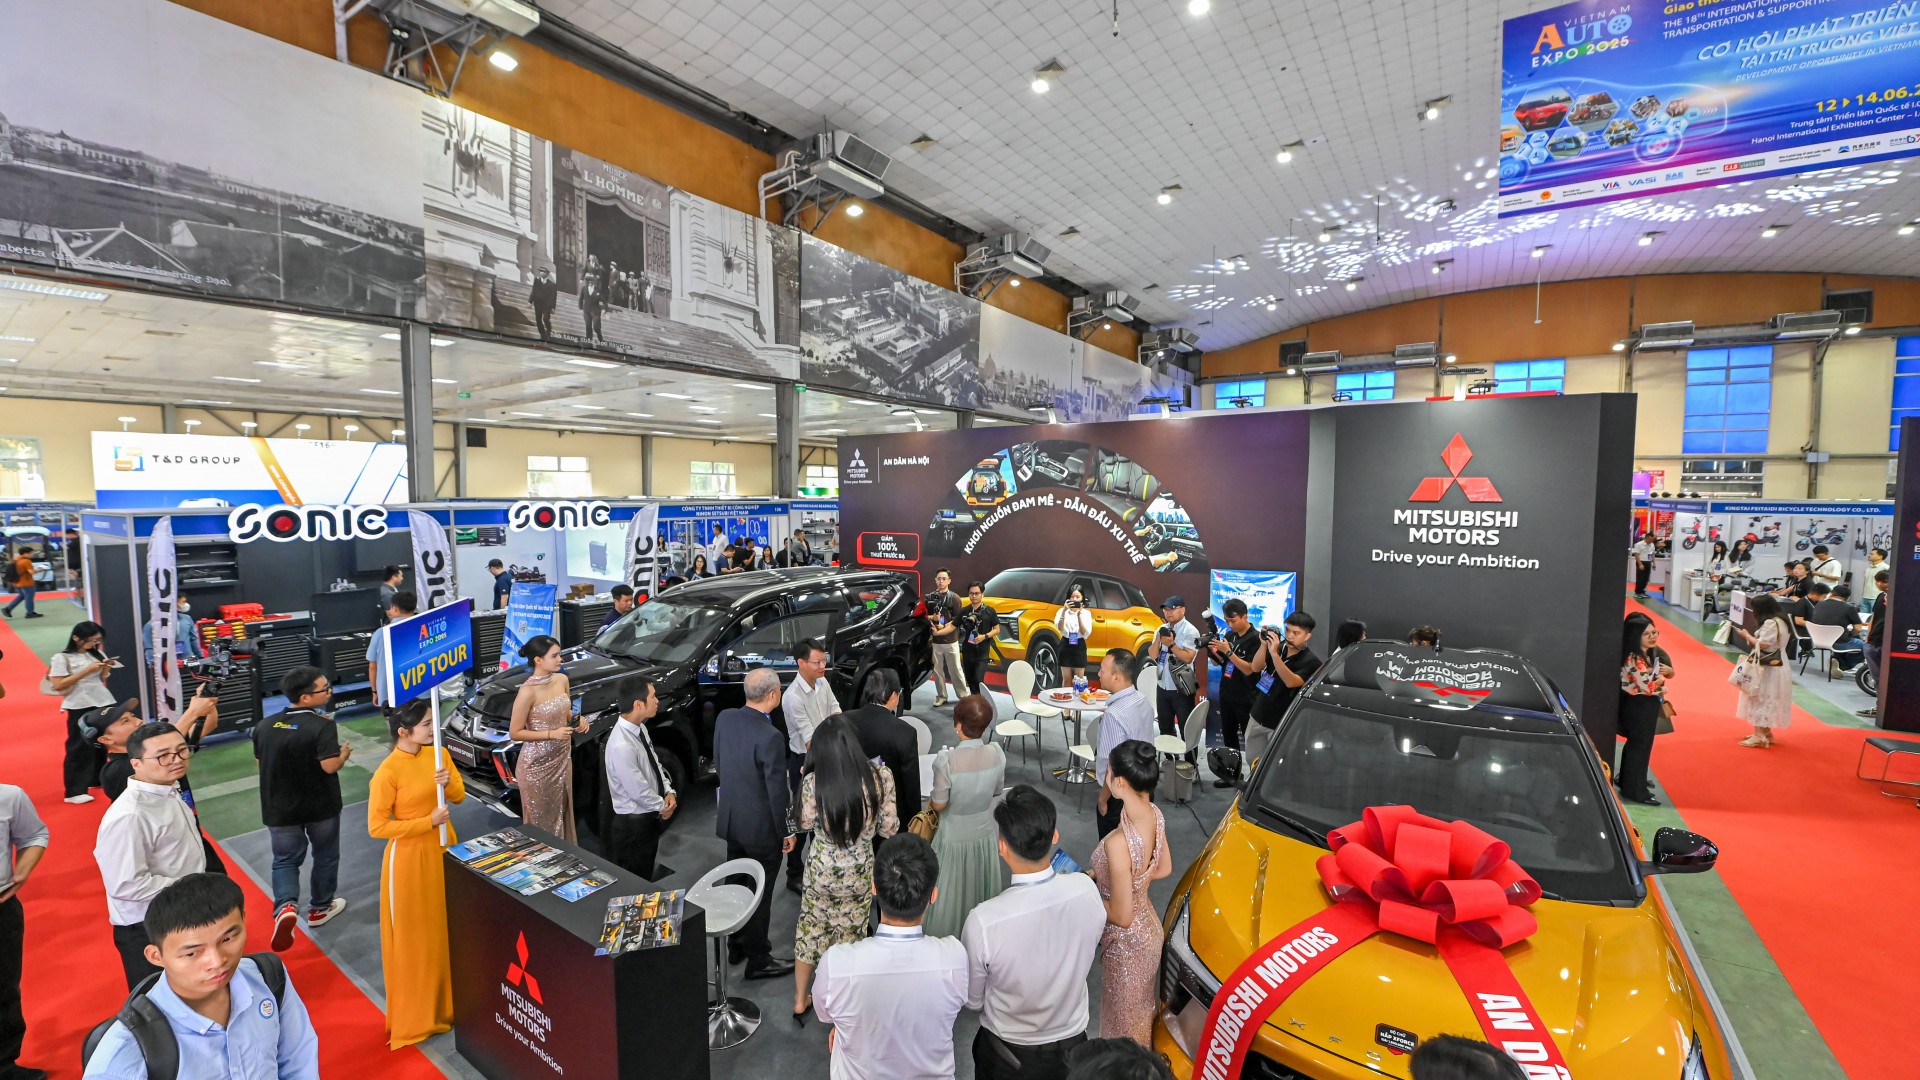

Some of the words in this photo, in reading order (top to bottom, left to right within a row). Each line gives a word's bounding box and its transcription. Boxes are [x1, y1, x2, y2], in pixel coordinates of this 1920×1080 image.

[1564, 4, 1631, 27] VIETNAM
[1664, 2, 1695, 15] Giao
[1531, 13, 1633, 55] AUTO
[1663, 18, 1683, 29] THE
[1663, 12, 1755, 39] TRANSPORTATION
[1756, 9, 1765, 18] &
[1697, 39, 1732, 62] CƠ
[1735, 30, 1779, 55] HỘI
[1782, 17, 1845, 44] PHÁT
[1850, 0, 1917, 29] TRIỂN
[1531, 47, 1579, 68] EXPO
[1586, 35, 1630, 56] 2025
[1739, 55, 1767, 69] TẠI
[1768, 49, 1797, 64] THỊ
[1735, 64, 1798, 82] DEVELOPMENT
[1798, 51, 1865, 70] OPPORTUNITY
[1790, 118, 1815, 129] Trung
[1816, 115, 1833, 125] tâm
[1834, 110, 1856, 121] Triển
[1874, 102, 1899, 114] Quốc
[1900, 99, 1911, 110] tế
[1815, 99, 1838, 113] 12
[1751, 134, 1776, 145] Hanoi
[1776, 125, 1830, 141] International
[1831, 118, 1874, 131] Exhibition
[1875, 113, 1906, 124] Center
[1602, 181, 1621, 190] VIA
[152, 455, 184, 464] T&D
[189, 455, 241, 465] GROUP
[883, 458, 893, 466] AN
[893, 456, 907, 466] DÂN
[908, 455, 917, 465] HÀ
[917, 455, 930, 466] NỘI
[964, 528, 983, 555] KHƠI
[1011, 496, 1036, 512] ĐAM
[1037, 493, 1054, 507] MÊ
[1109, 523, 1127, 542] XU
[1393, 509, 1519, 528] MITSUBISHI
[877, 542, 898, 552] 100%
[1408, 527, 1500, 546] MOTORS
[1371, 549, 1413, 563] Drive
[1416, 553, 1455, 567] your
[1457, 553, 1540, 570] Ambition
[419, 621, 447, 641] AUTO
[419, 637, 434, 649] EXPO
[399, 662, 427, 691] VIP
[428, 643, 468, 677] TOUR
[461, 749, 474, 759] SPORT
[1254, 926, 1339, 989] MOTORS
[500, 982, 552, 1032] MITSUBISHI
[1476, 992, 1535, 1030] AN
[508, 1003, 546, 1043] MOTORS
[495, 1011, 513, 1034] Drive
[513, 1028, 530, 1047] your
[530, 1040, 564, 1076] Ambition
